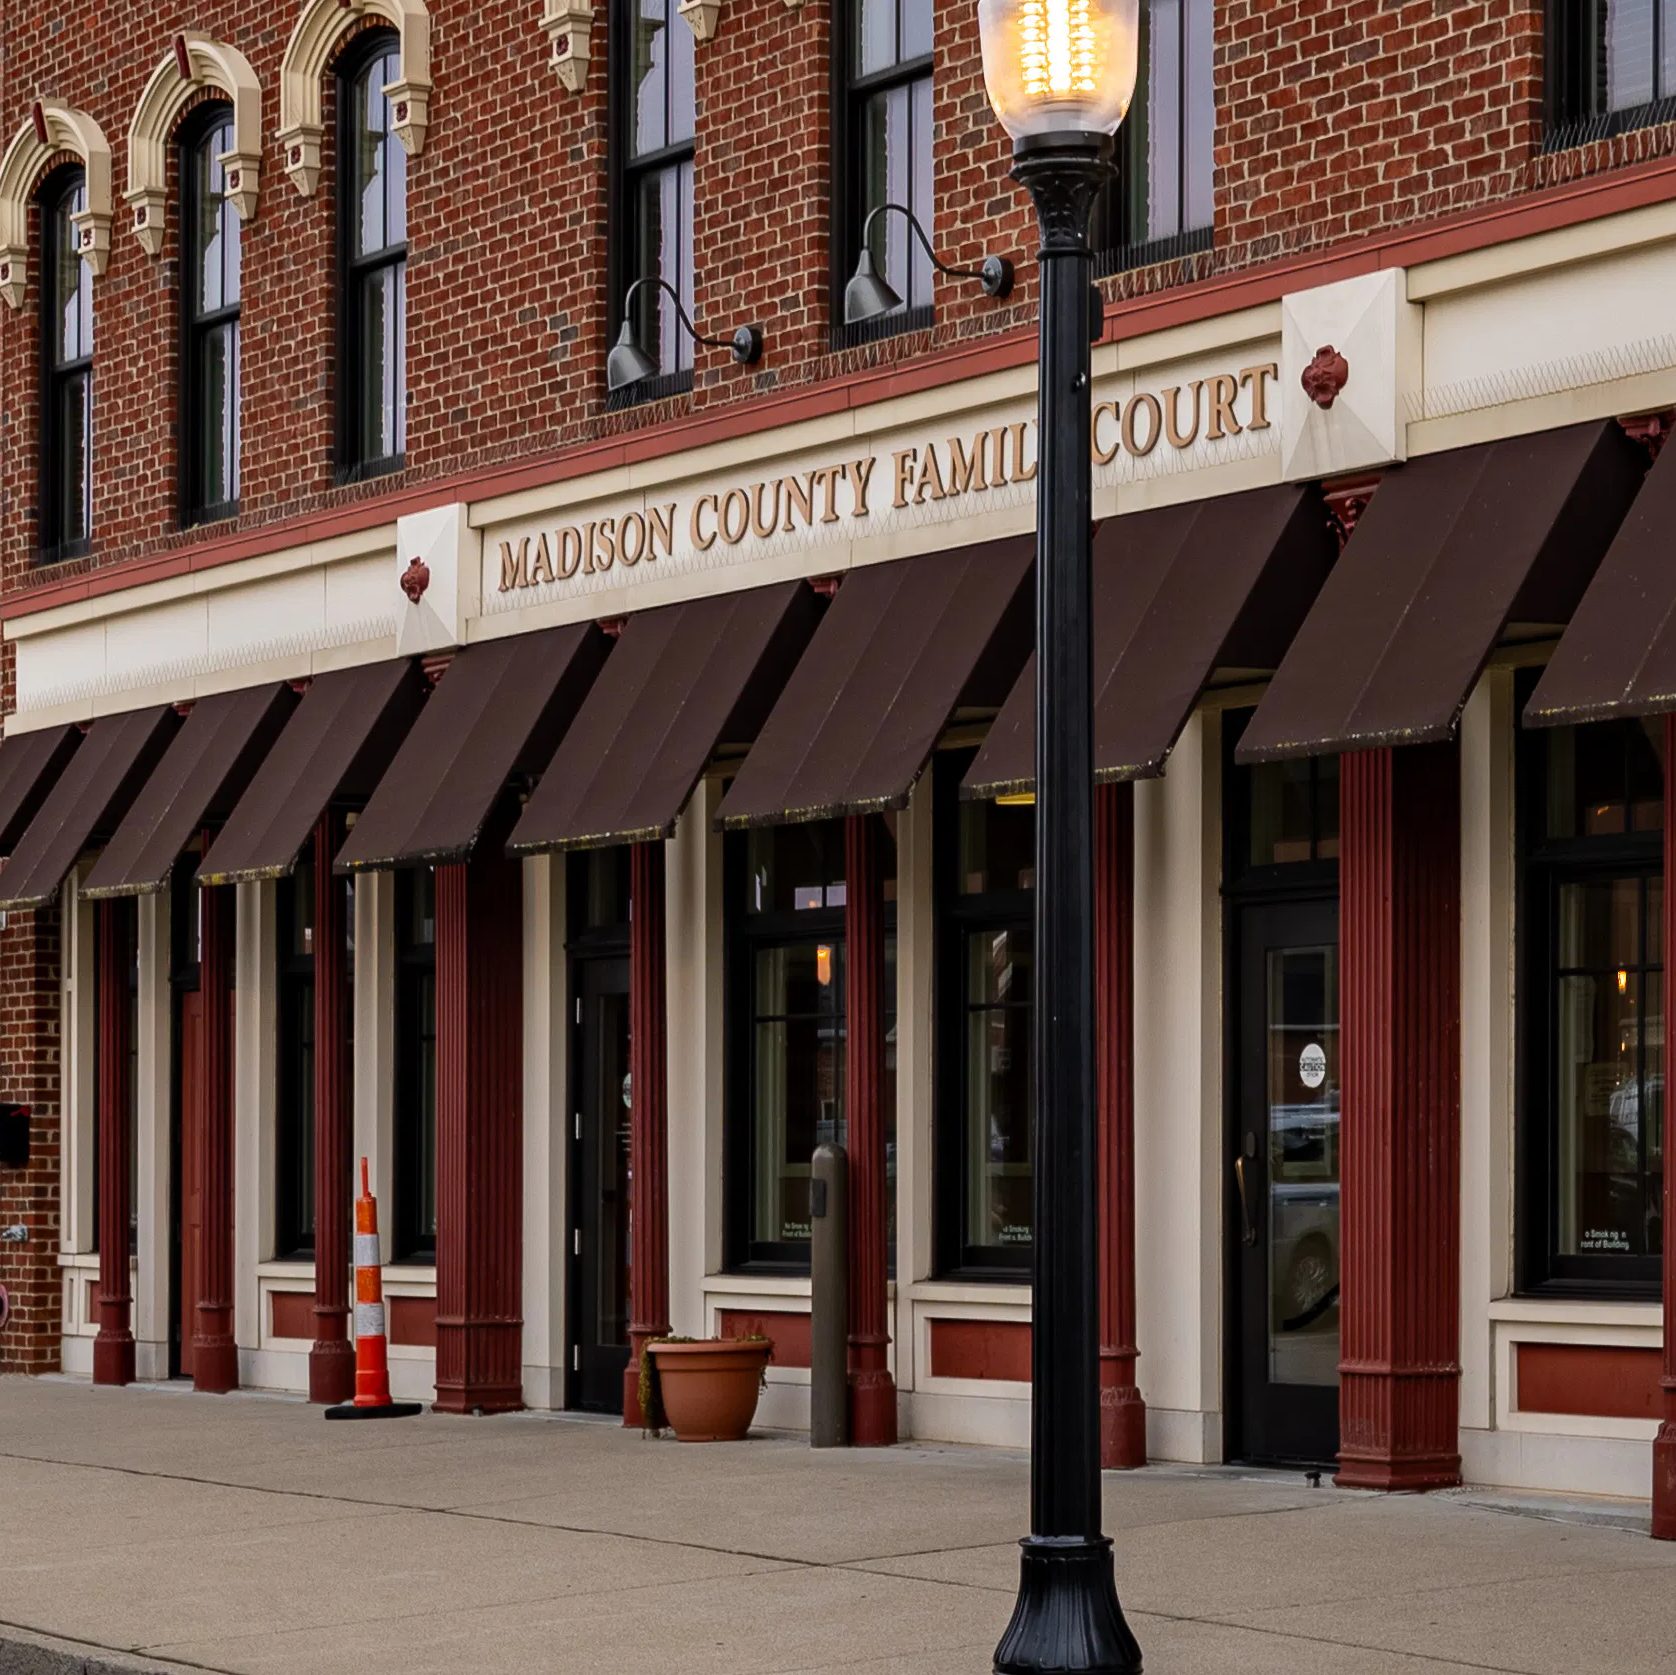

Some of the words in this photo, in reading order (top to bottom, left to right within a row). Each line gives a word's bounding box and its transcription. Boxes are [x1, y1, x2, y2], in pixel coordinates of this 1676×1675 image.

[498, 503, 677, 592] MADISON
[689, 457, 876, 551] COUNTY
[892, 419, 1038, 508] FAMIL
[1091, 362, 1278, 466] COURT
[1590, 1229, 1619, 1241] Smokng
[1580, 1240, 1594, 1249] ront
